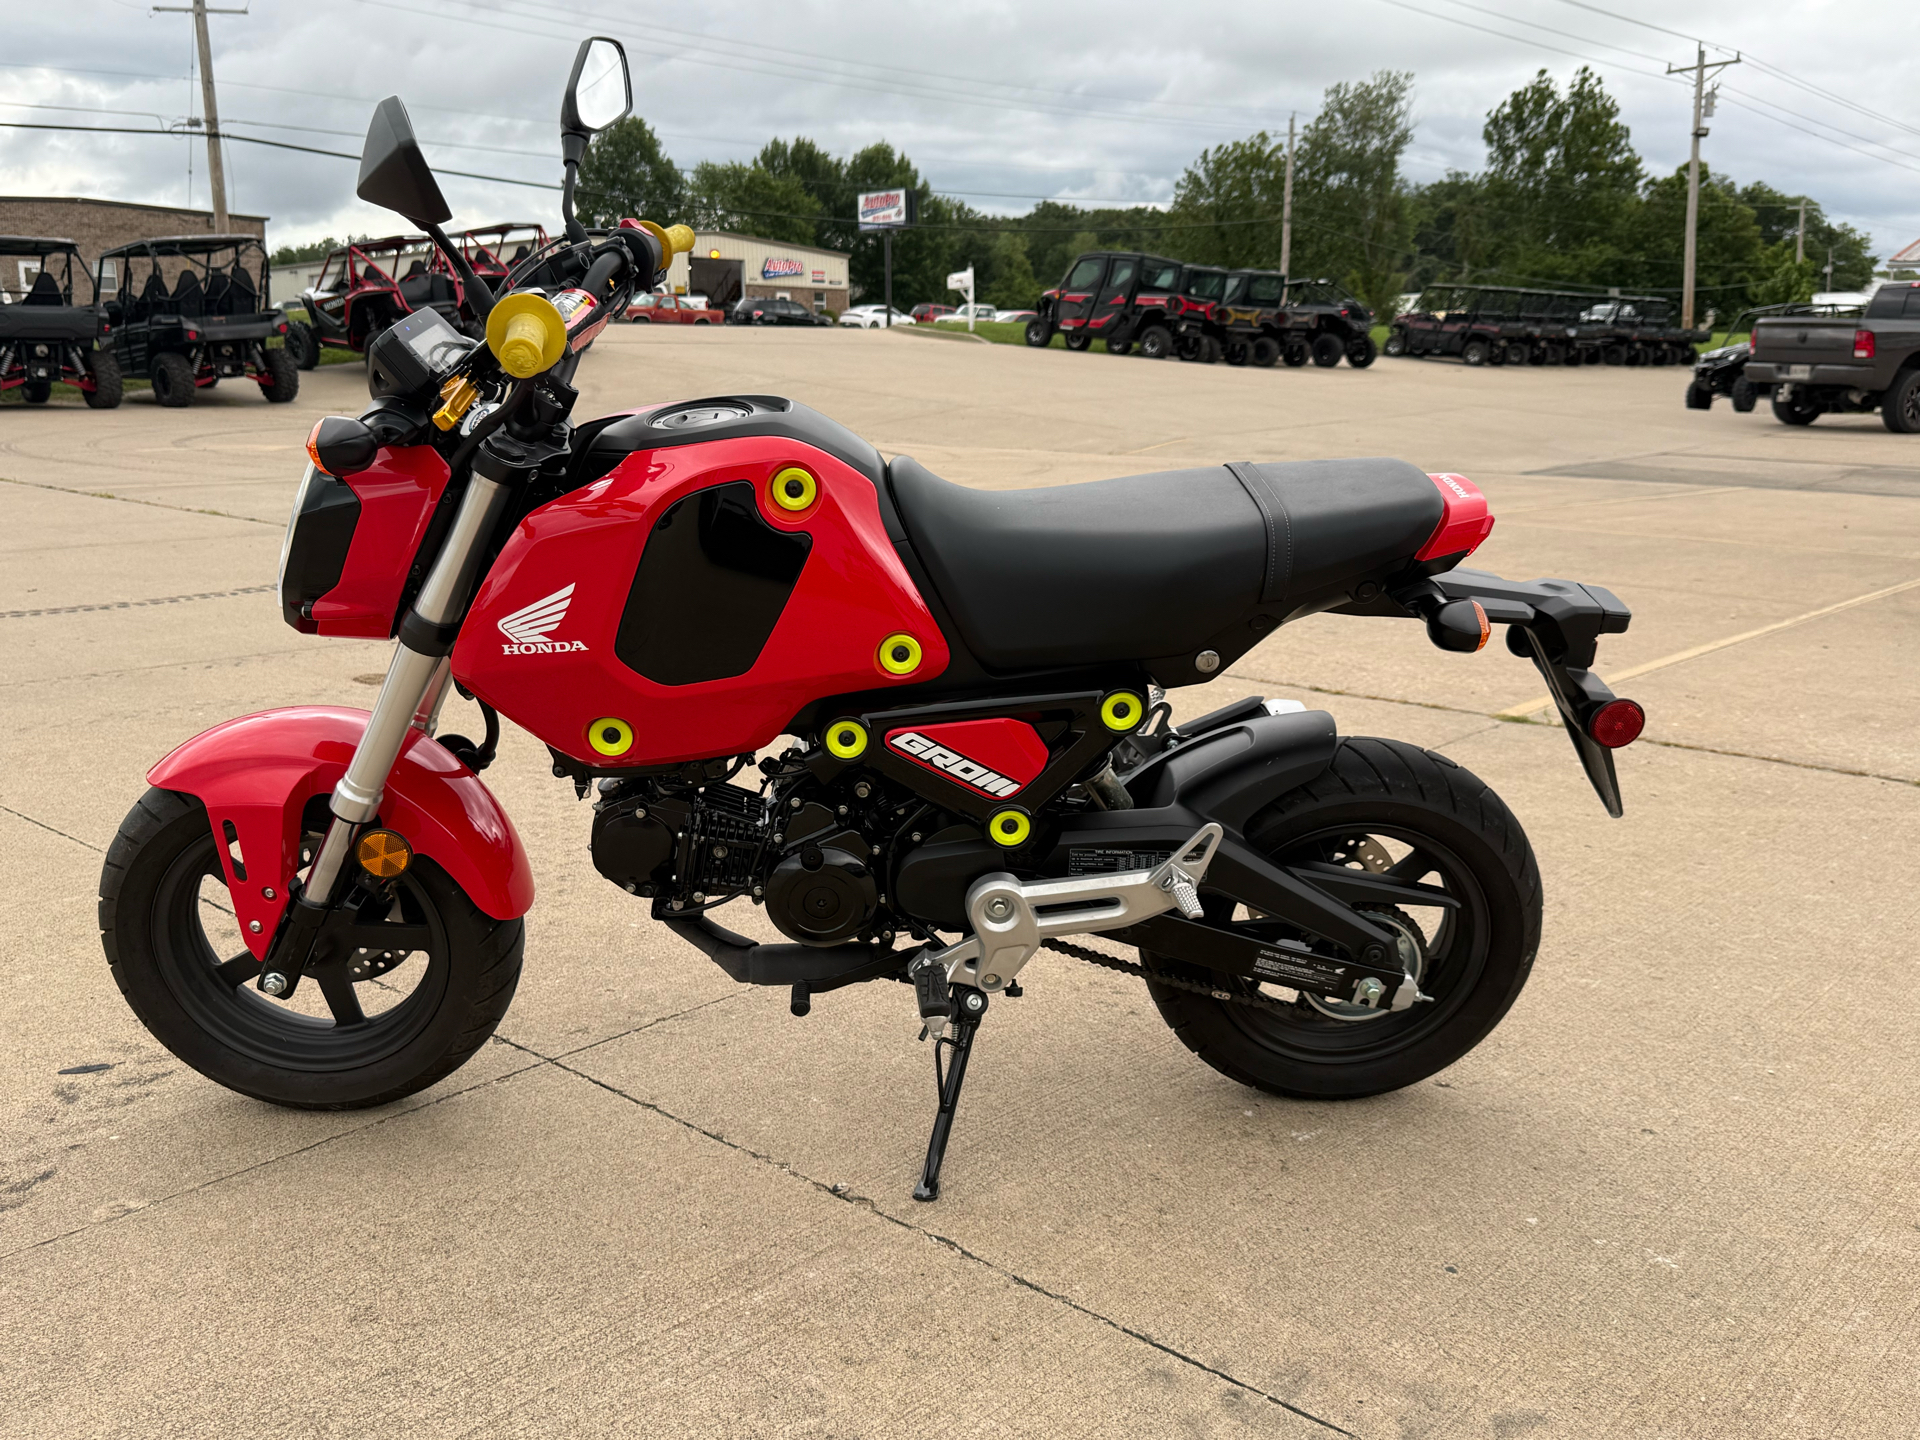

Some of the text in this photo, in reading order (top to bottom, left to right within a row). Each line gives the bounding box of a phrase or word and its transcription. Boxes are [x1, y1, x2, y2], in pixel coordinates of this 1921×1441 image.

[323, 297, 345, 311] HONDA
[1438, 474, 1470, 498] HONDA
[501, 640, 590, 655] HONDA
